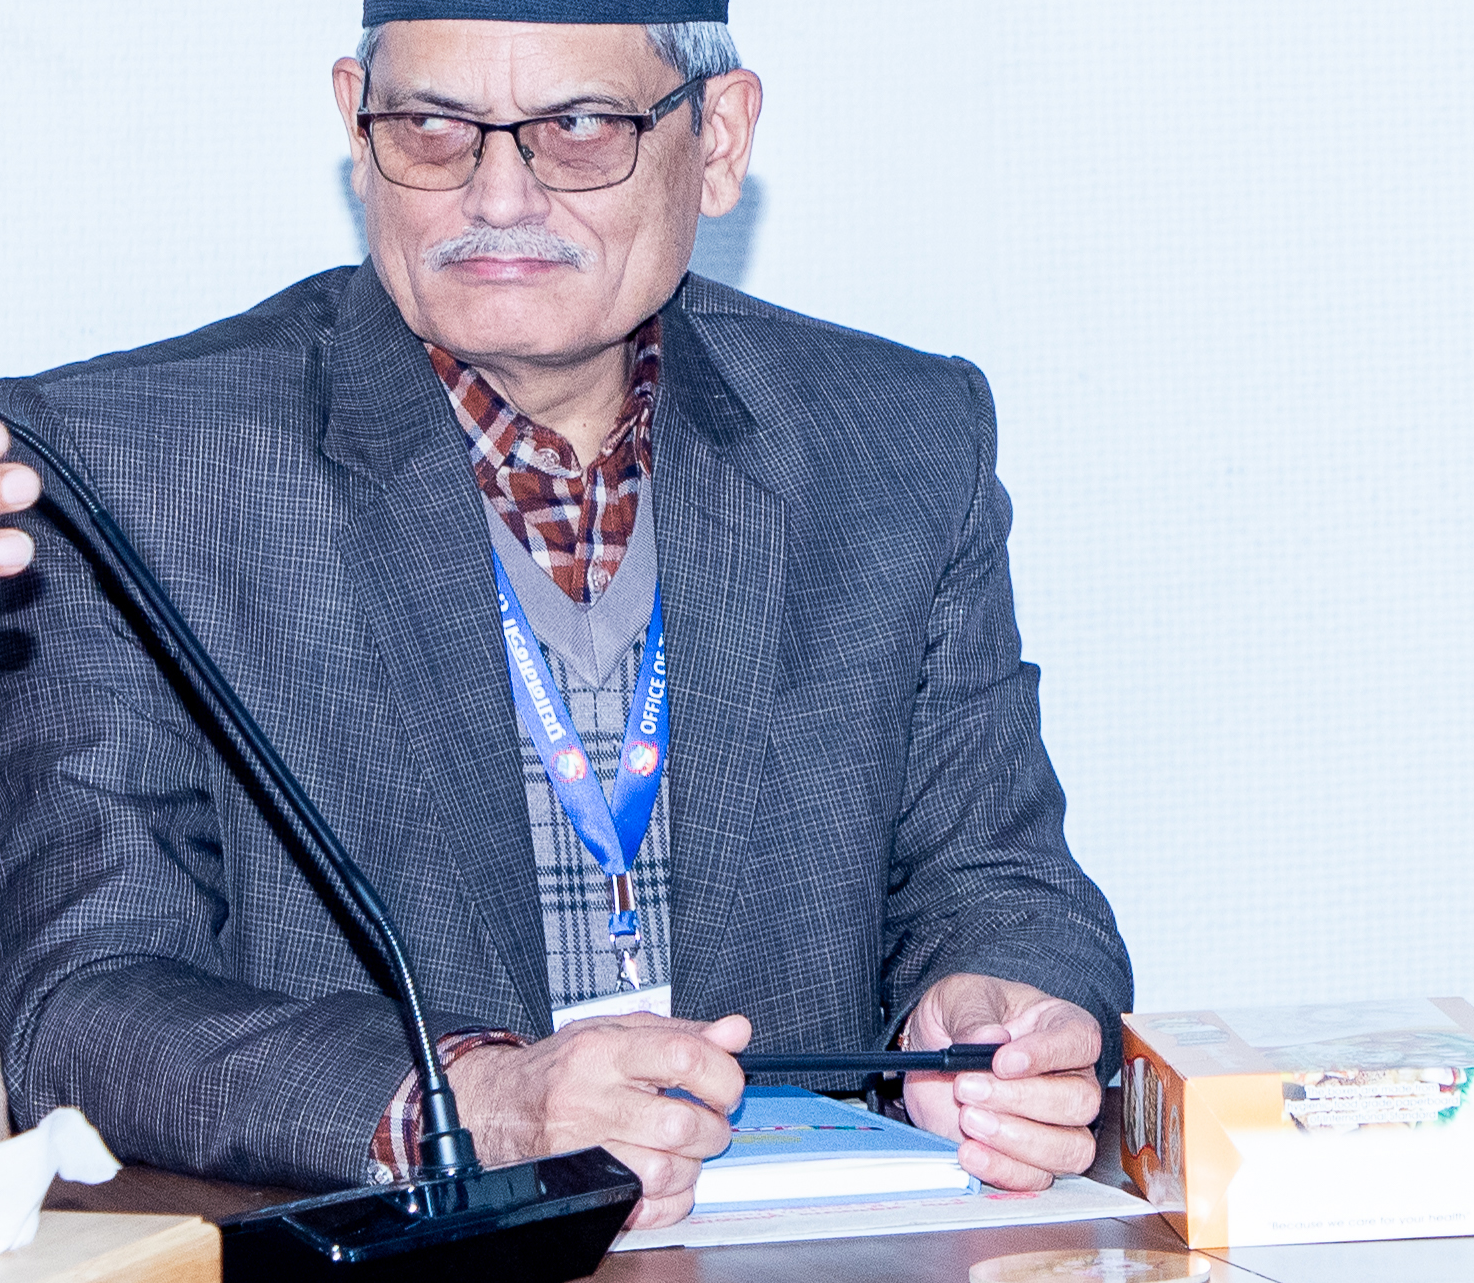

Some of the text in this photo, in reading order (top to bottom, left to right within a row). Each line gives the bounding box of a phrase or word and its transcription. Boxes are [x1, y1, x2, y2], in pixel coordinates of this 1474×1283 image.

[640, 677, 666, 735] OFFICE
[1327, 1084, 1358, 1096] boxes
[1380, 1083, 1413, 1094] made
[1414, 1082, 1439, 1093] from
[1333, 1098, 1359, 1110] food
[1361, 1098, 1393, 1110] grade
[1394, 1095, 1460, 1110] paperboard
[1327, 1219, 1345, 1228] we
[1348, 1217, 1377, 1227] care
[1380, 1215, 1395, 1226] for
[1399, 1215, 1425, 1227] your
